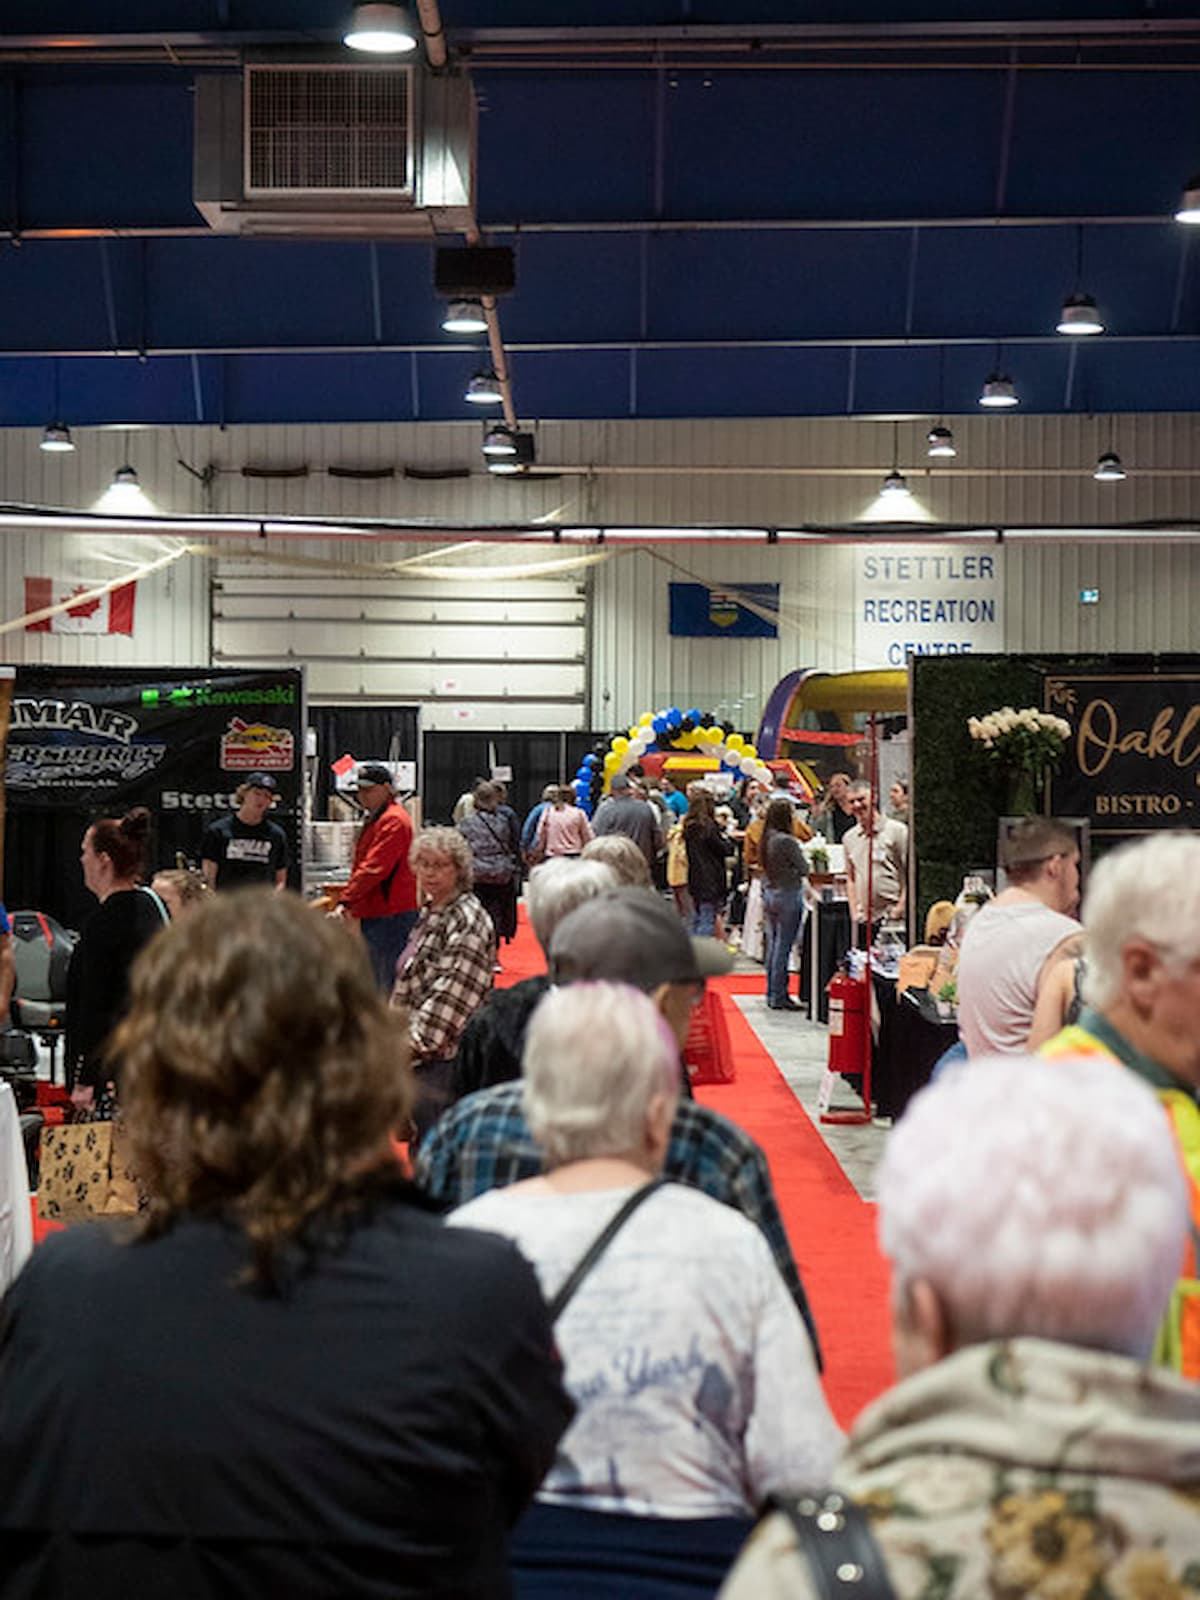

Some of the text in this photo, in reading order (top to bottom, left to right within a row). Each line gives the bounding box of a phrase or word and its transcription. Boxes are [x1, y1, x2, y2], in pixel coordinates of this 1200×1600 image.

[864, 556, 994, 580] STETTLER
[864, 600, 995, 623] RECREATION
[1095, 794, 1181, 815] BISTRO
